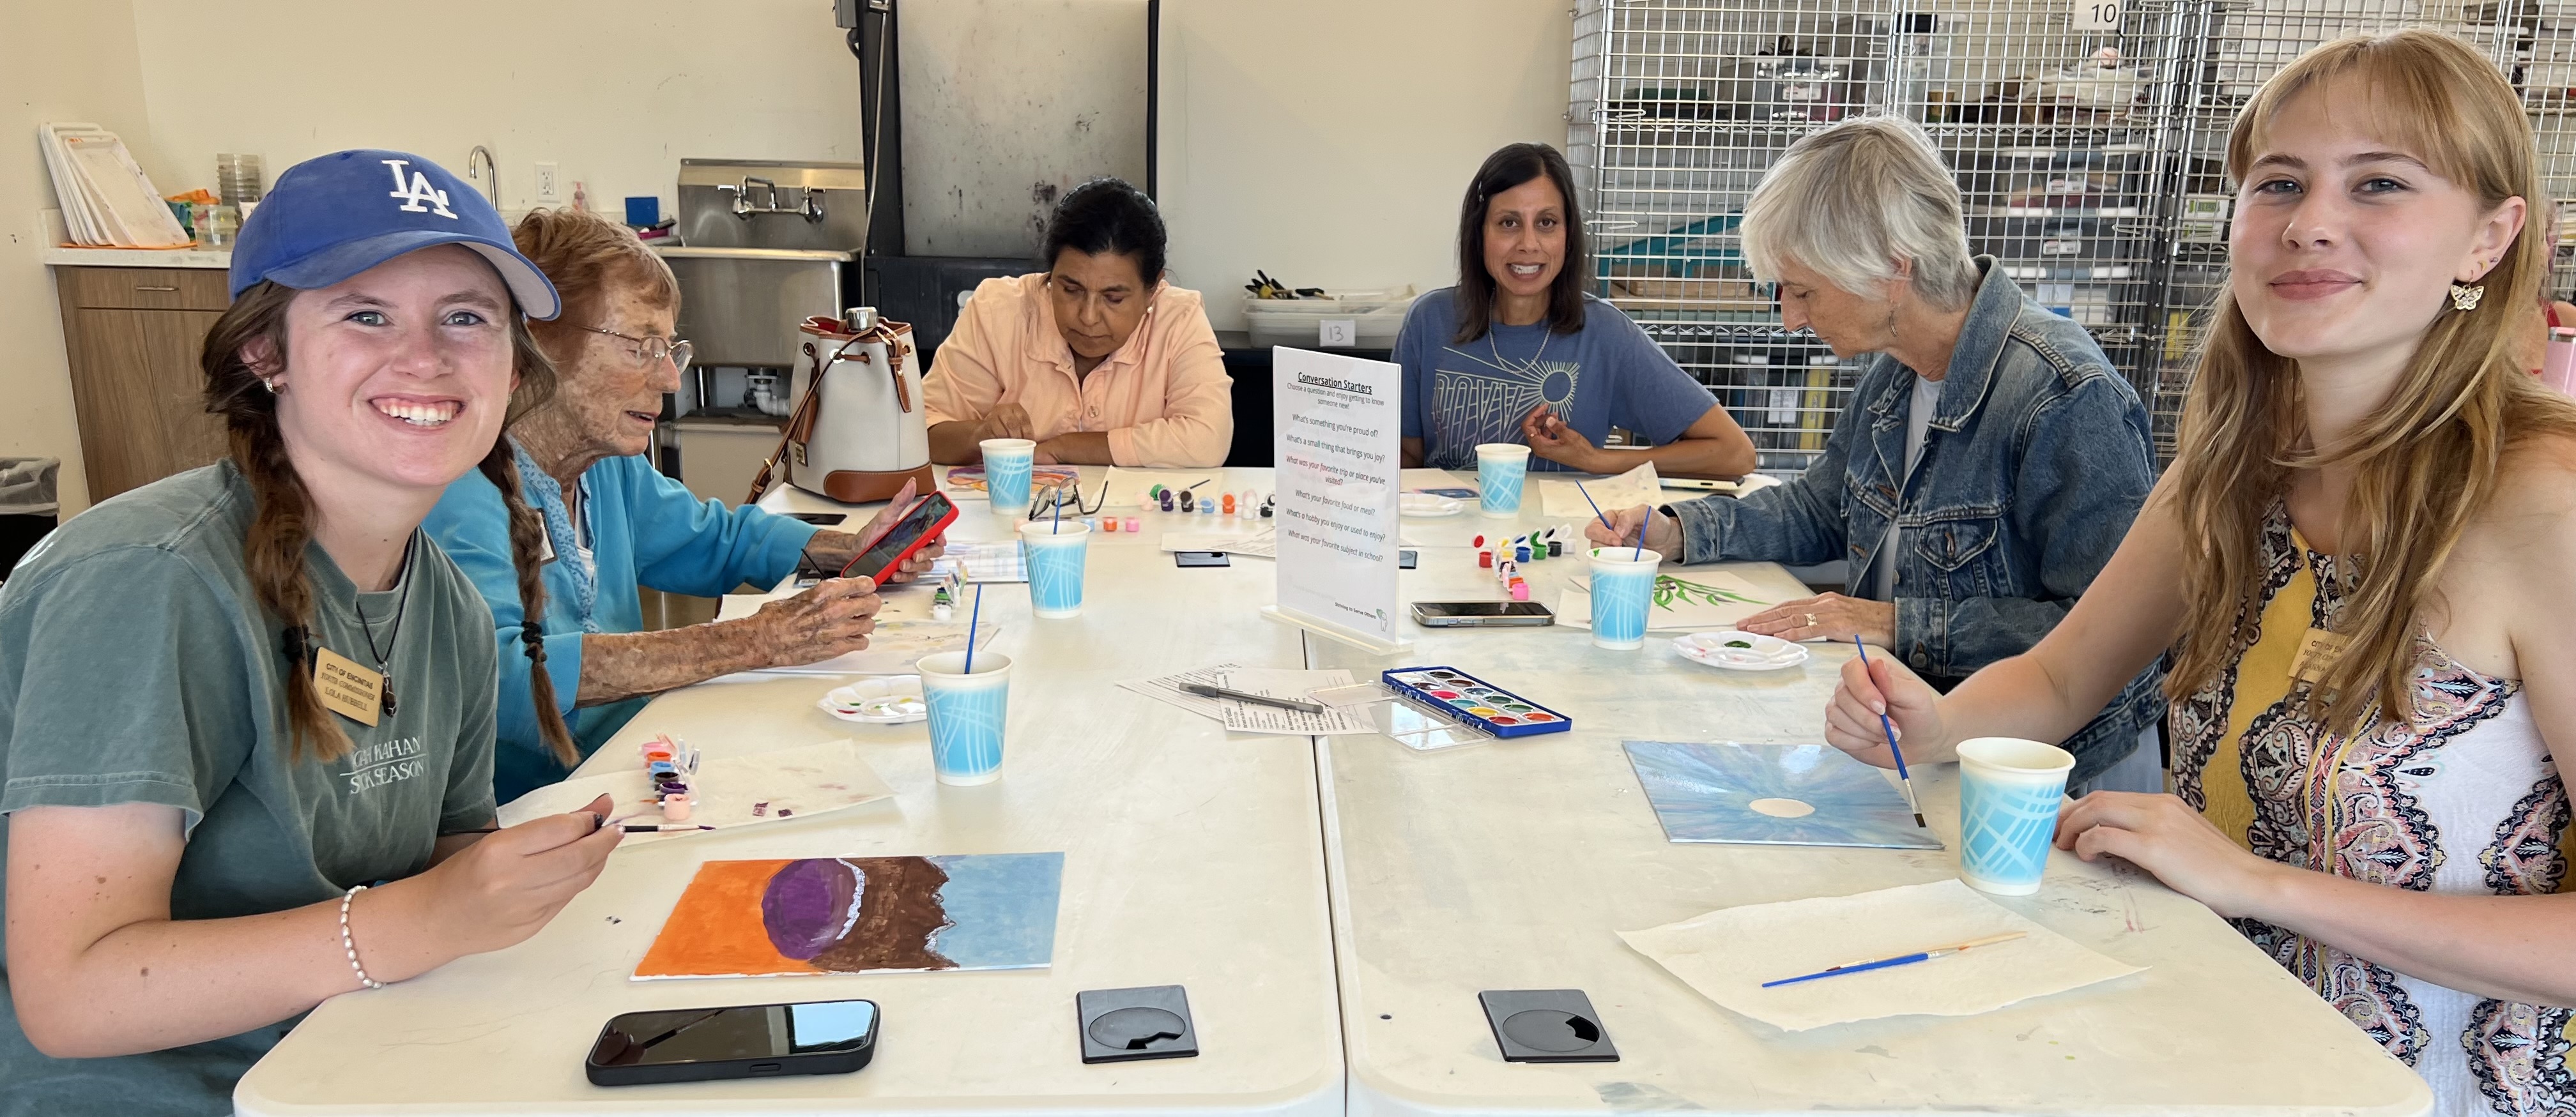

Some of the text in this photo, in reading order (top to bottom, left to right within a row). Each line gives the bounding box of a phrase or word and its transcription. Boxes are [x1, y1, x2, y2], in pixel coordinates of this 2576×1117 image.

[2092, 4, 2116, 23] 10
[381, 160, 458, 220] LA
[1329, 326, 1344, 342] 13
[1287, 383, 1303, 391] Choose
[1336, 392, 1348, 401] enjoy
[1349, 395, 1365, 404] getting
[1372, 397, 1384, 406] know
[1298, 372, 1372, 394] Conversation Starters
[1317, 399, 1338, 407] someone
[1292, 413, 1379, 438] What's something you're proud of?
[1286, 434, 1302, 444] What's
[1307, 439, 1320, 448] small
[1321, 441, 1335, 453] thing
[1335, 445, 1346, 454] that
[1346, 446, 1362, 459] brings
[1363, 452, 1373, 460] you
[1374, 452, 1385, 464] joy?
[1286, 455, 1298, 464] What
[1299, 459, 1308, 467] was
[1320, 463, 1339, 474] favorite
[1339, 467, 1348, 478] trip
[1356, 471, 1368, 481] place
[1369, 475, 1385, 485] you've
[1325, 476, 1344, 485] visited?
[1296, 489, 1310, 499] What's
[1311, 494, 1321, 503] your
[1322, 496, 1340, 508] favorite
[1341, 501, 1353, 510] food
[1360, 507, 1376, 516] meal?
[1286, 508, 1301, 519] What's
[1306, 513, 1321, 525] hobby
[1321, 518, 1330, 526] you
[1330, 521, 1344, 531] enjoy
[1351, 526, 1362, 535] used
[1363, 529, 1368, 537] to
[1370, 531, 1386, 542] enjoy?
[1288, 529, 1300, 539] What
[1310, 536, 1321, 545] your
[1321, 538, 1340, 551] favorite
[1340, 545, 1358, 556] subject
[1365, 552, 1383, 563] school?
[1335, 602, 1348, 611] Striving
[326, 663, 338, 673] CITY
[374, 736, 421, 761] KAHAN
[374, 759, 424, 786] SEASON
